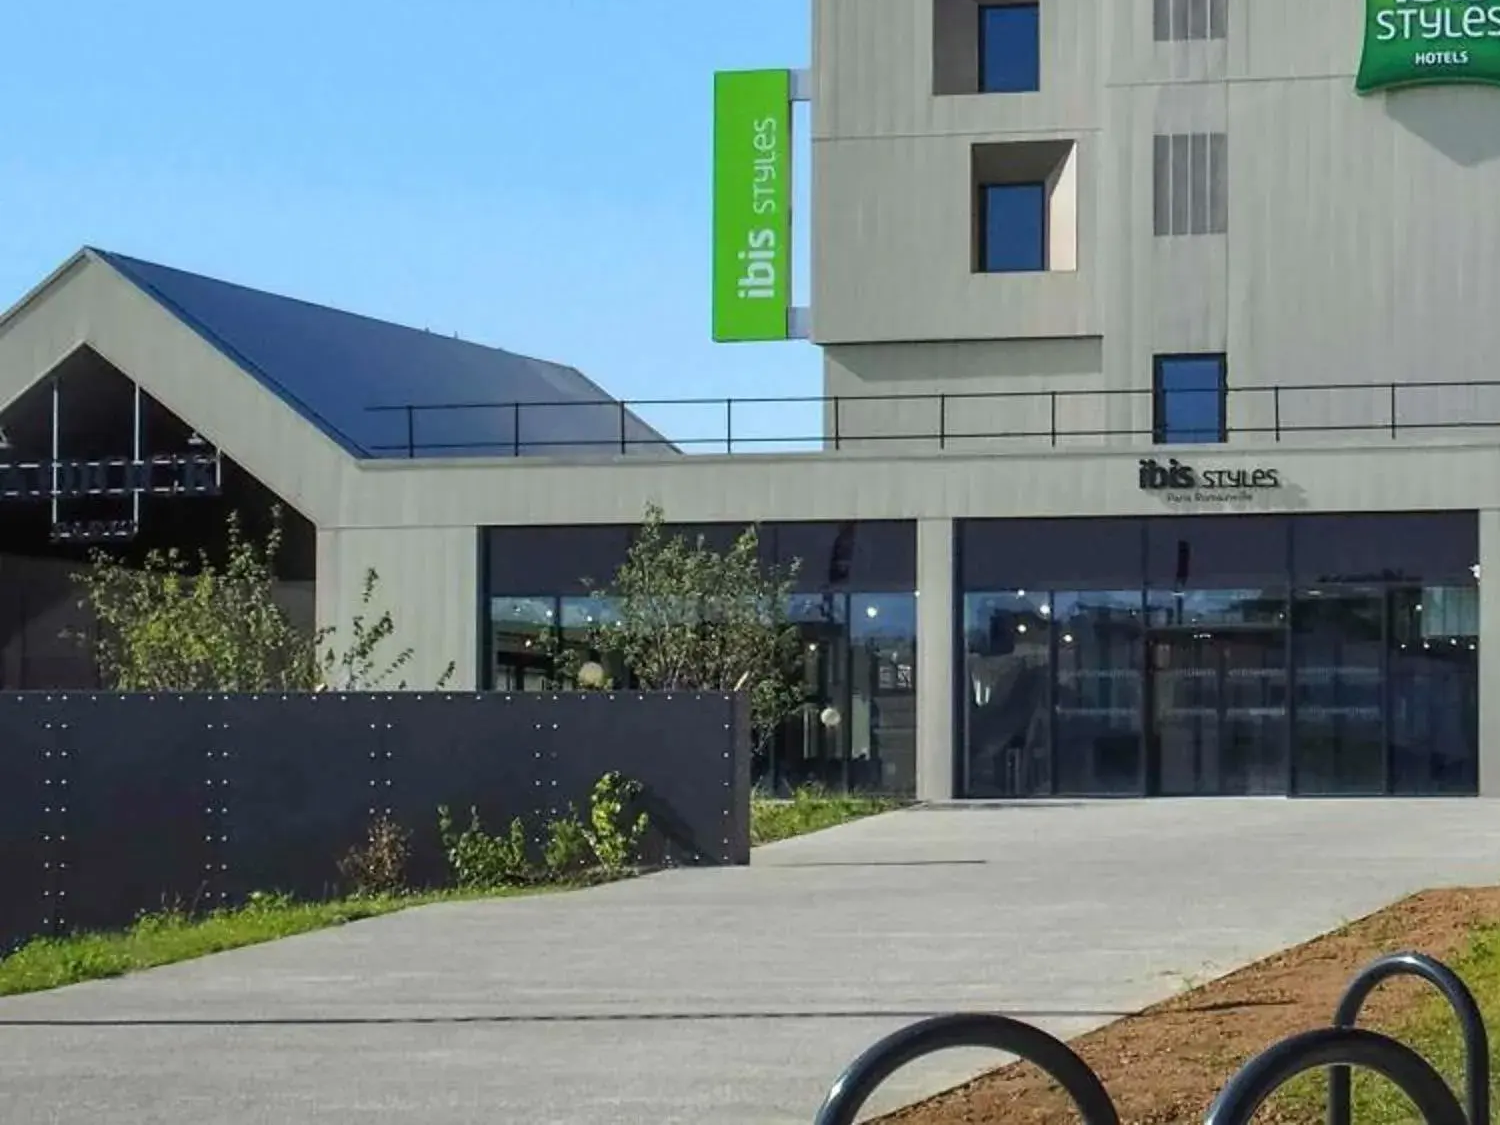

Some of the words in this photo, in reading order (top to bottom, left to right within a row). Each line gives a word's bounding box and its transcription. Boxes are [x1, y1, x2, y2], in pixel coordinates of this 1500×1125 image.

[1415, 50, 1468, 65] HOTELS
[737, 229, 775, 299] ibis
[1139, 458, 1195, 489] ibis
